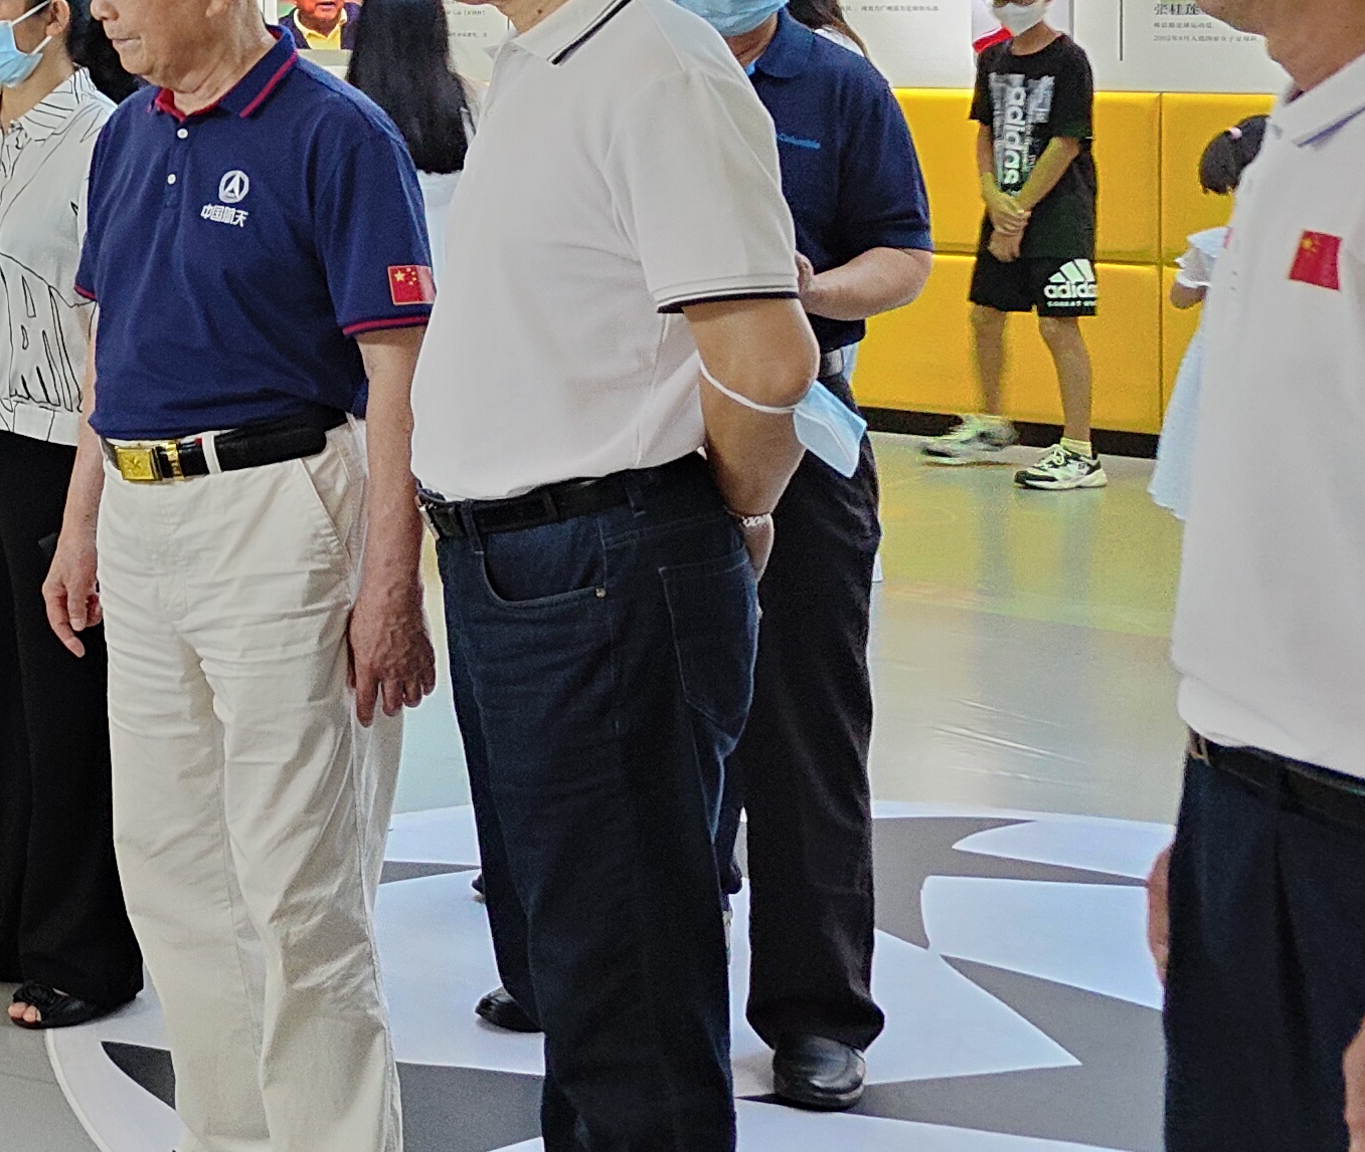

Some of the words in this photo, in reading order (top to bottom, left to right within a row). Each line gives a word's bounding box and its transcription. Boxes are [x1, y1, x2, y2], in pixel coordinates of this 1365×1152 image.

[1003, 86, 1027, 185] adidas
[200, 203, 249, 228] 中国航天
[1044, 280, 1098, 299] adida
